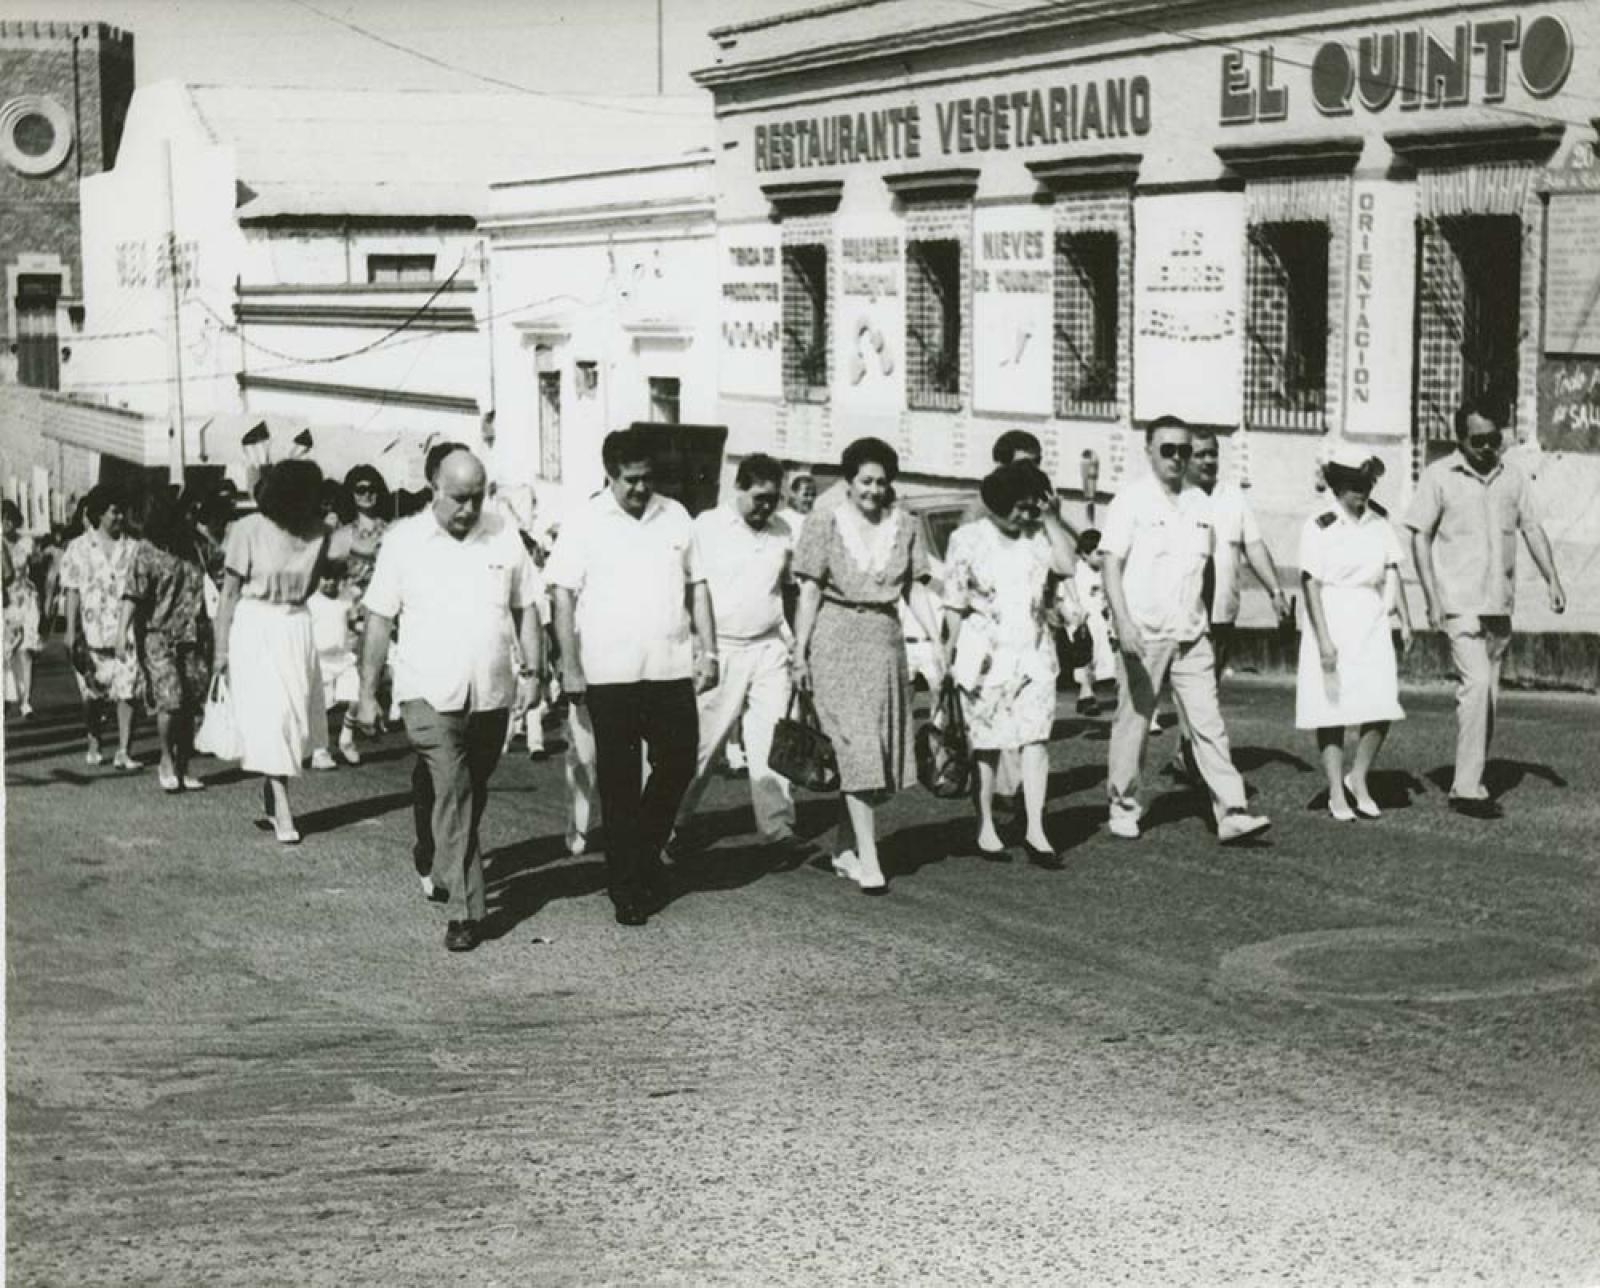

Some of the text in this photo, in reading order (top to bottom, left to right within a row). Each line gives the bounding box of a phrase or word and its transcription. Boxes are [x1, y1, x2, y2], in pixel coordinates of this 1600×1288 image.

[1219, 14, 1574, 127] EL QUINTO
[754, 75, 1152, 172] RESTAURANTE VEGETARIANO
[982, 230, 1044, 260] NIEVES
[1353, 193, 1375, 404] ORIENTACION
